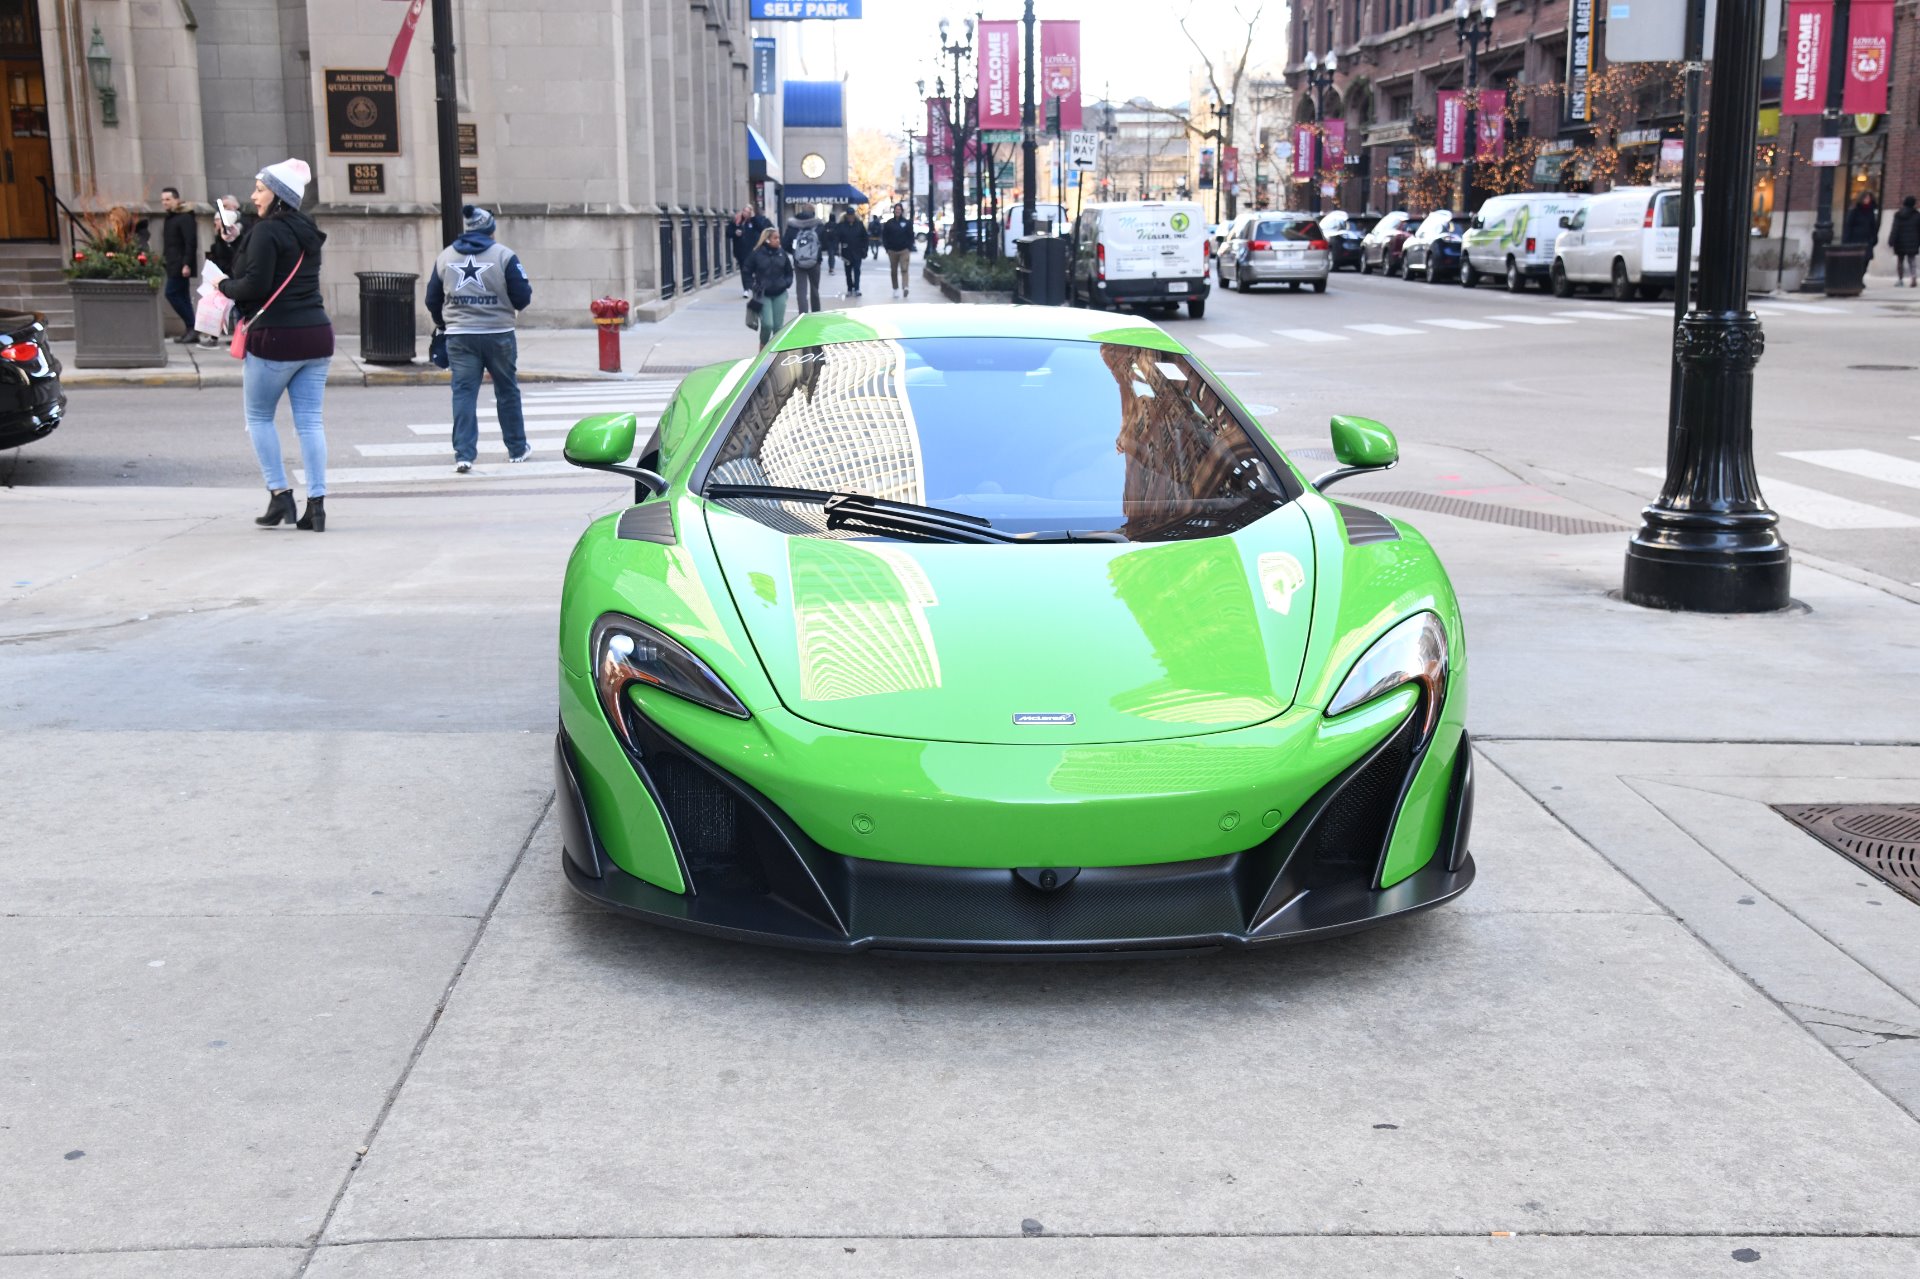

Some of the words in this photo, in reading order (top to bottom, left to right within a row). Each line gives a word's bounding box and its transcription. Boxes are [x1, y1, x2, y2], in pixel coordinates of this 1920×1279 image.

[764, 3, 802, 16] SELF
[806, 3, 848, 16] PARK
[1794, 13, 1812, 101] WELCOME
[988, 32, 1002, 116] WELCOME
[328, 84, 361, 92] QUIGLEY
[1442, 99, 1452, 154] WELCOME
[1074, 134, 1096, 142] ONE
[1073, 146, 1096, 154] WAY
[355, 165, 378, 178] 835
[445, 295, 498, 305] COWBOYS
